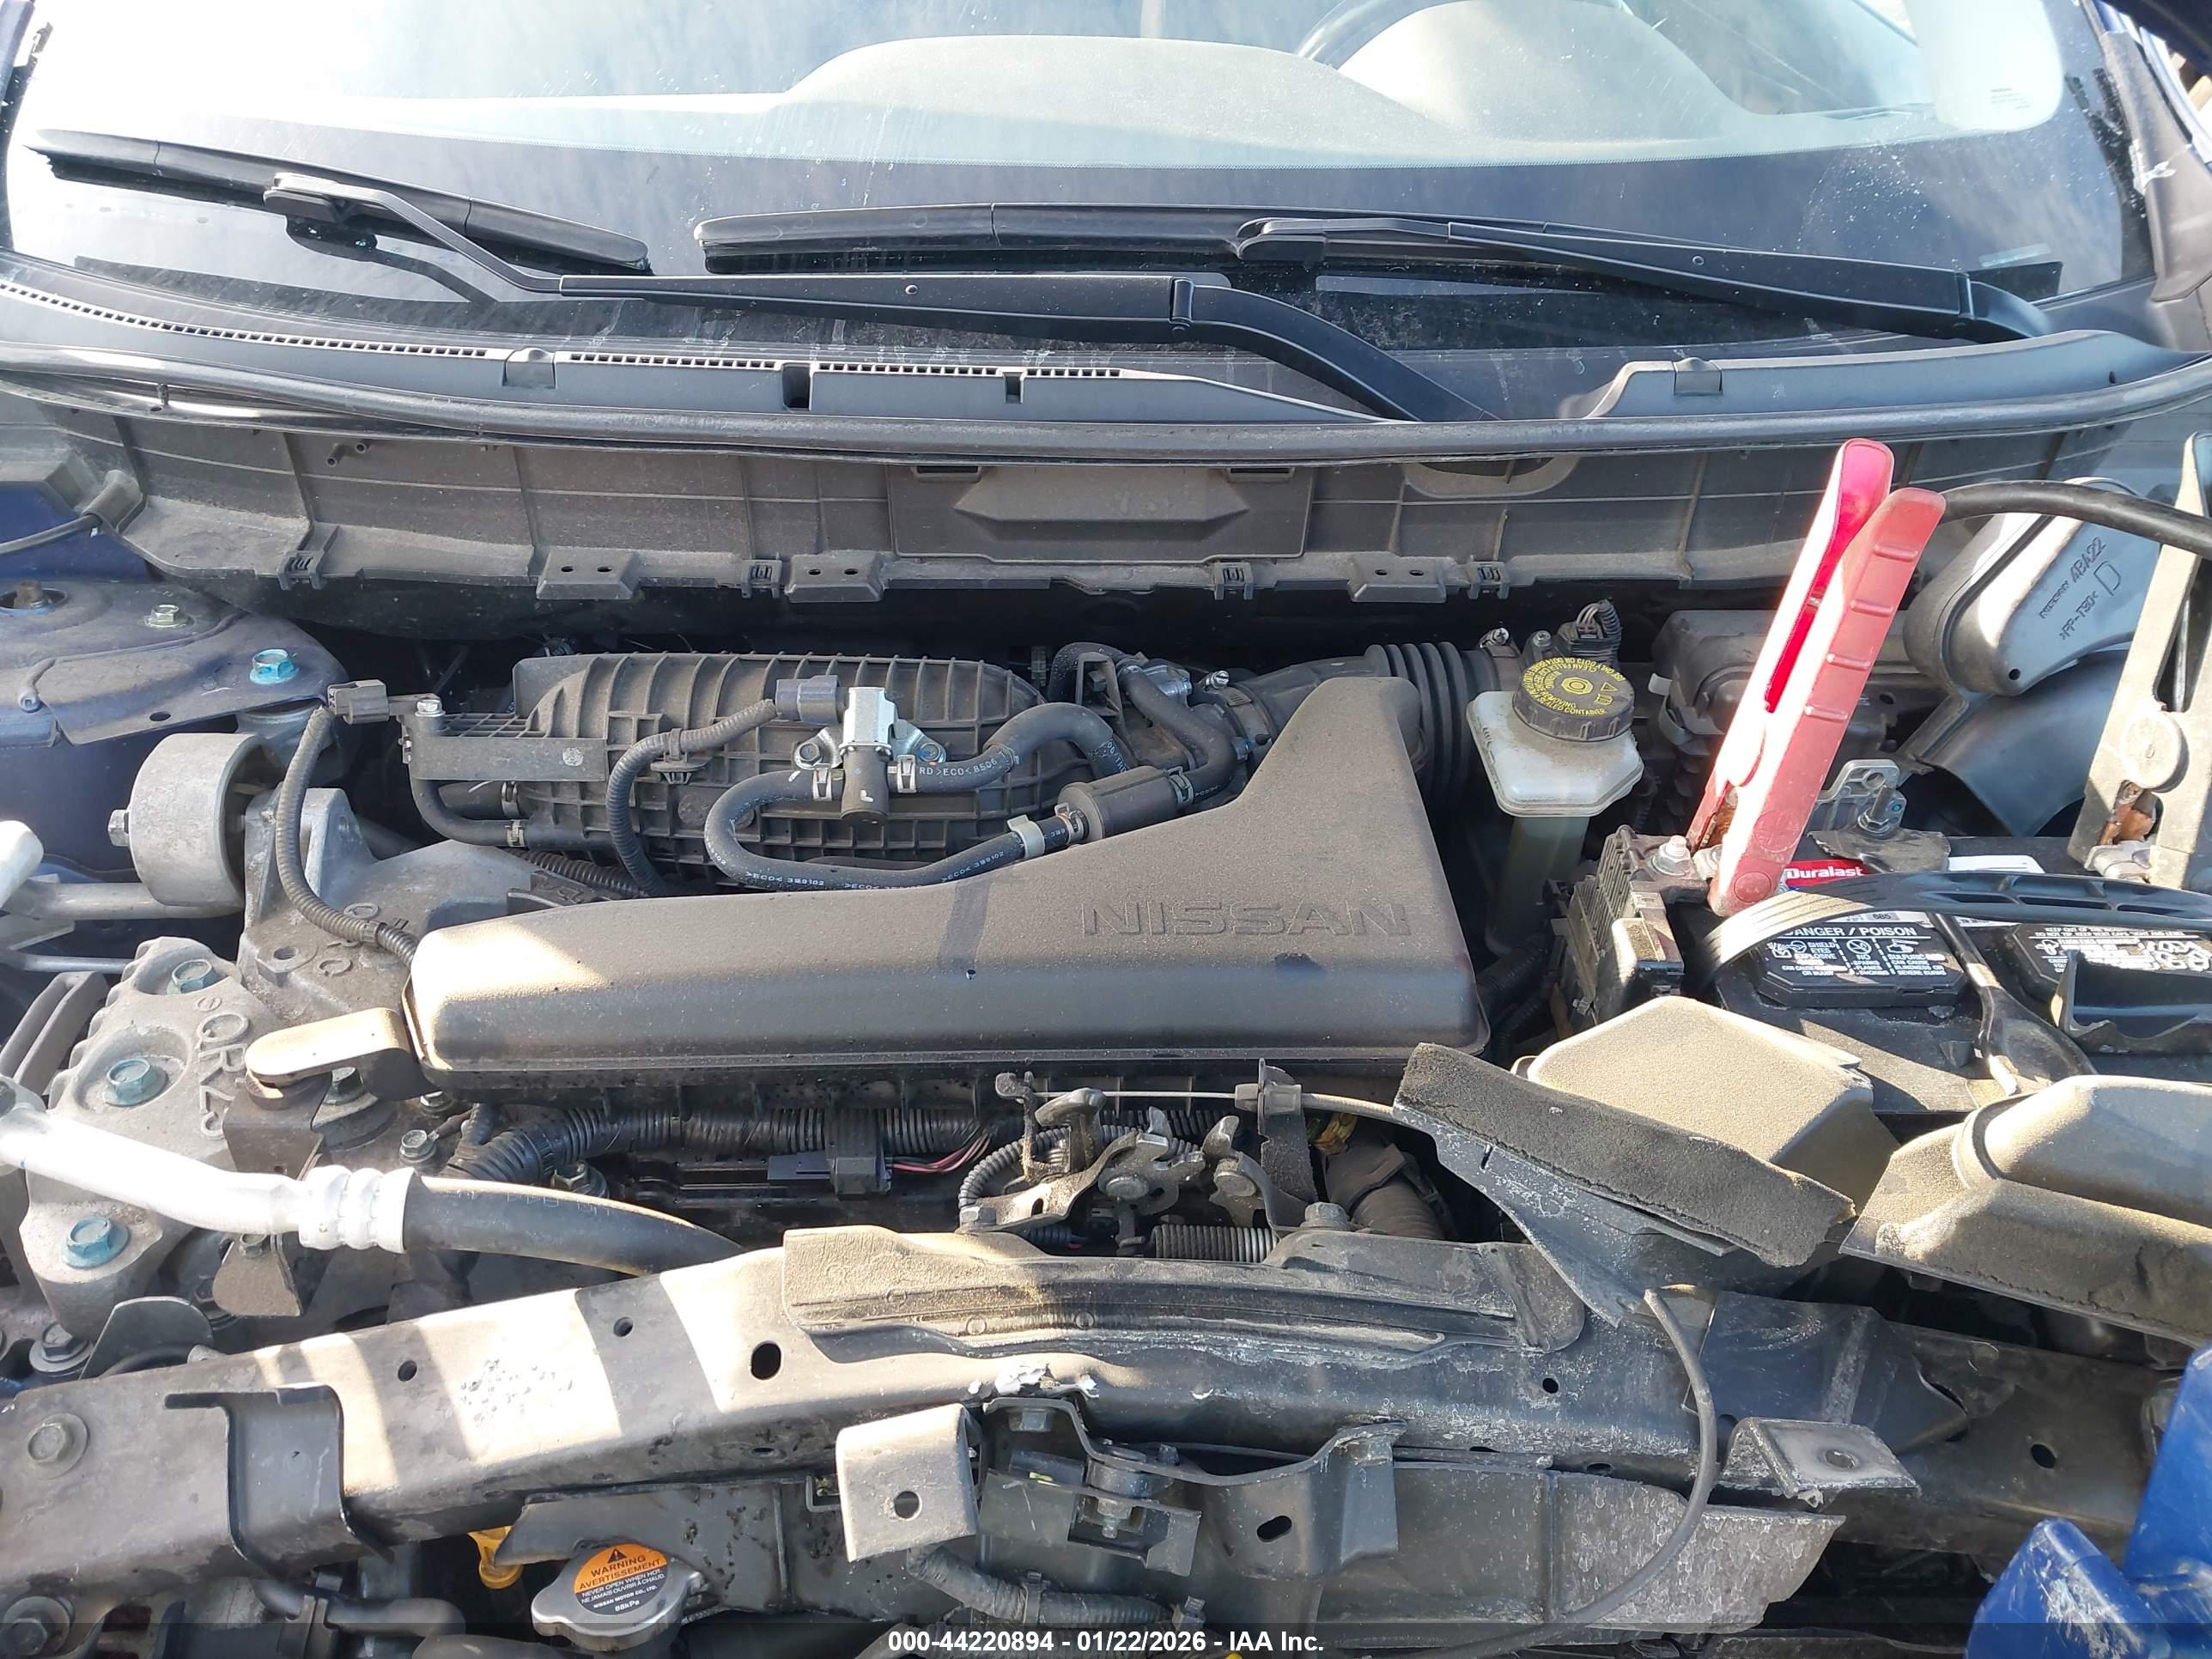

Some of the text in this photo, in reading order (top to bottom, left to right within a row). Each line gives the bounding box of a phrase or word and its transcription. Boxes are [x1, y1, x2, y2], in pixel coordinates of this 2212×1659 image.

[1785, 866, 1864, 879] Duralast
[1081, 900, 1411, 937] NISSAN
[1858, 927, 1917, 936] POISON
[580, 1559, 661, 1589] AVERTISSEMENT
[591, 1555, 646, 1577] WARNING
[582, 1585, 605, 1597] NEVER
[605, 1580, 624, 1590] OPEN
[624, 1572, 647, 1585] WHEN
[593, 1599, 615, 1608] NISSAN
[615, 1592, 635, 1601] MOTOR
